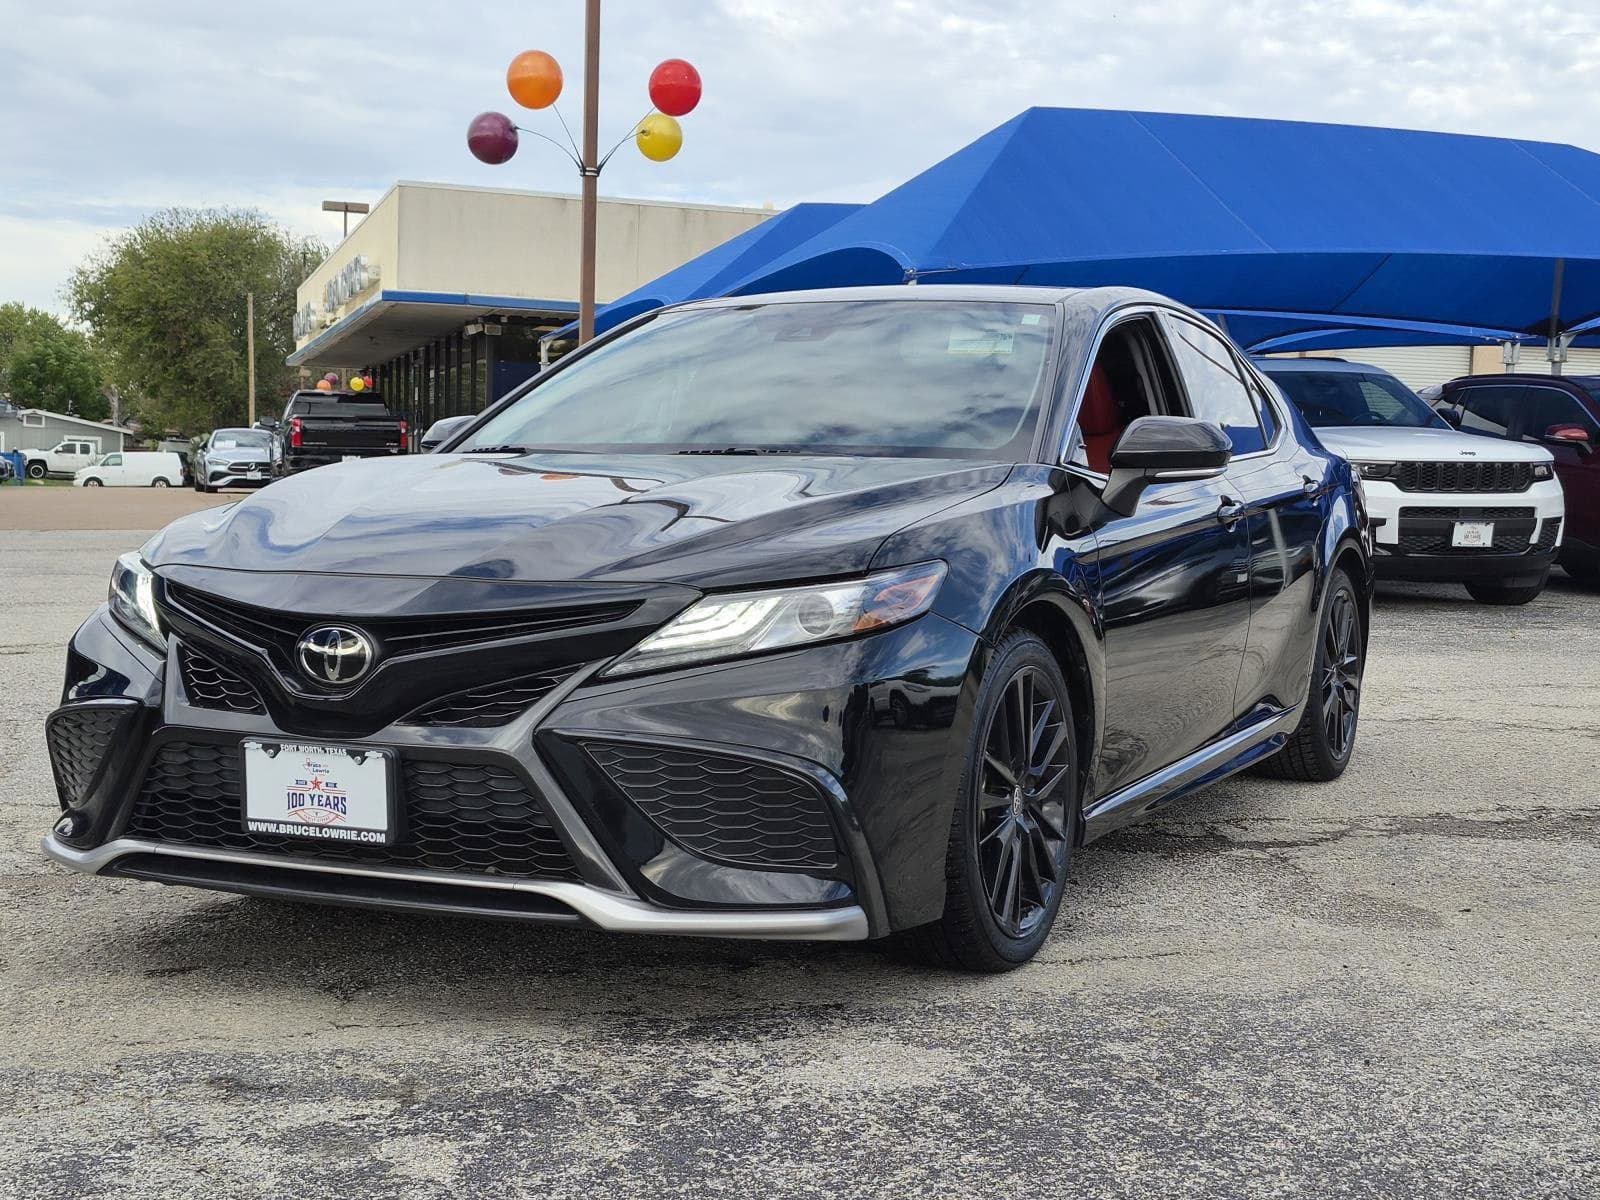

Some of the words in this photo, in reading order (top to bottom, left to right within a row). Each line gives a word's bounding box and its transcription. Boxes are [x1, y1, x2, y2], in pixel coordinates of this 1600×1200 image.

[325, 747, 347, 756] TEXAS
[287, 792, 305, 810] 100
[309, 793, 347, 815] YEARS
[247, 821, 386, 843] WWW.BRUCELOWRIE.COM
